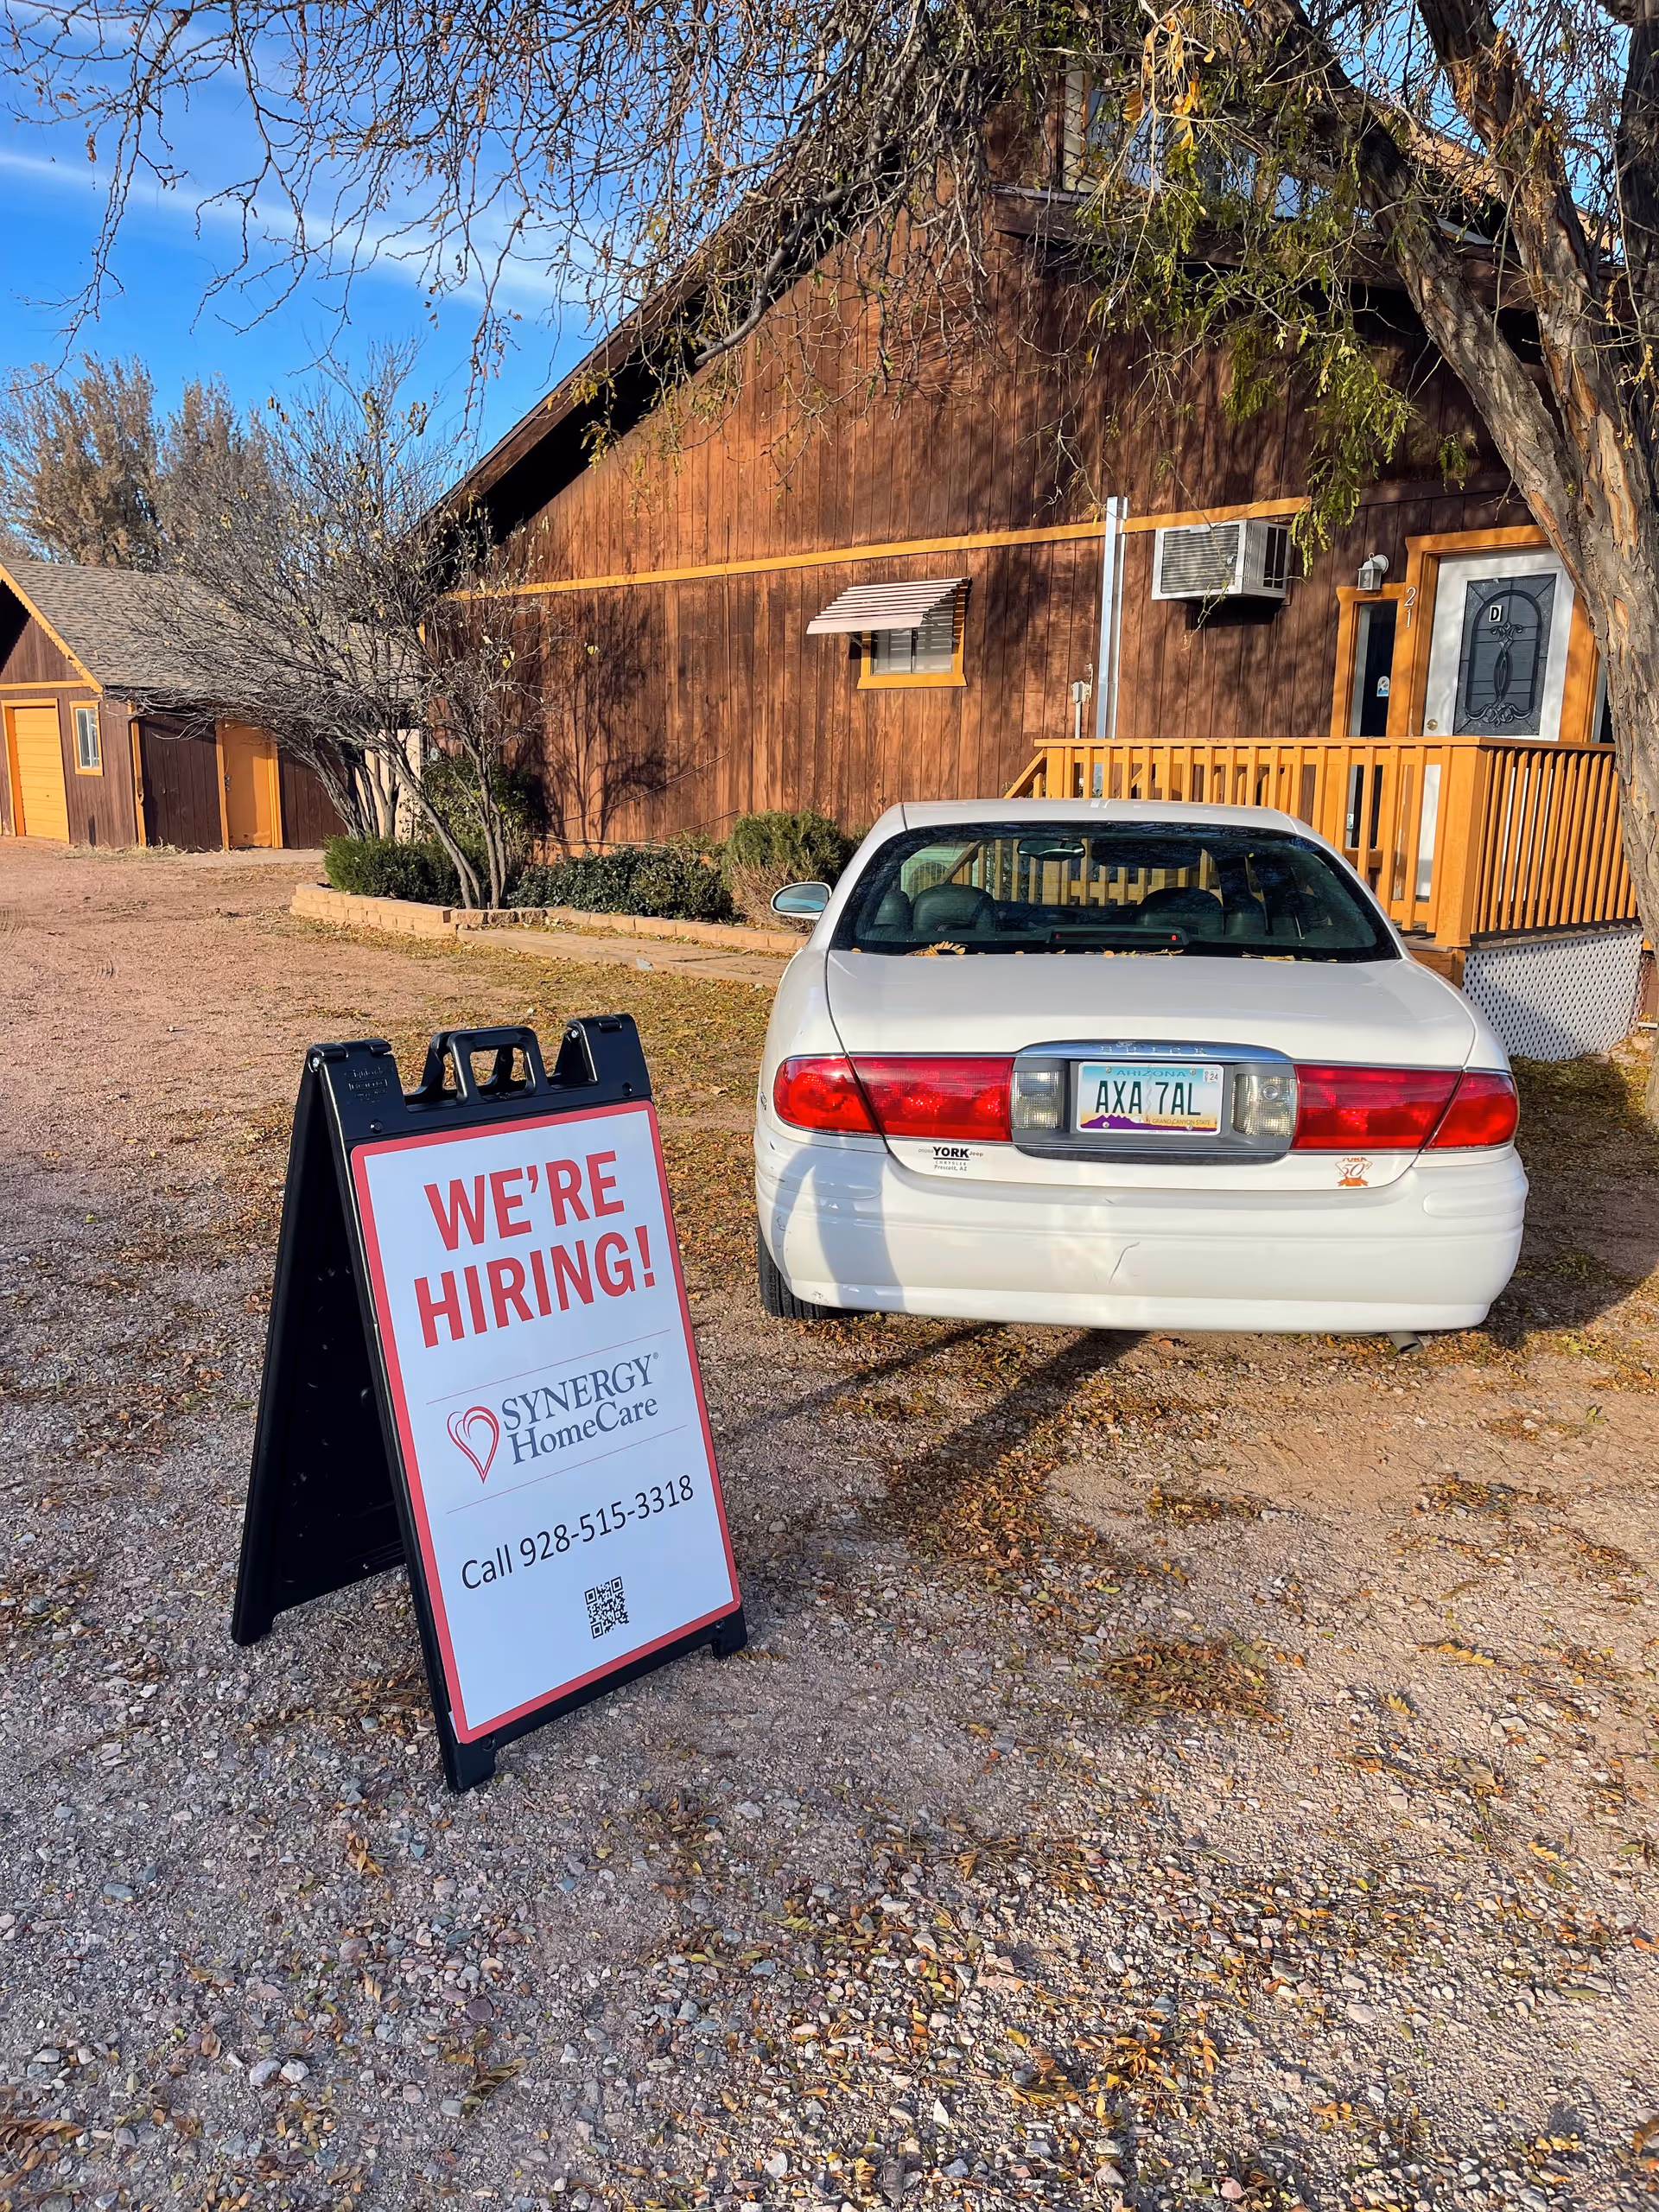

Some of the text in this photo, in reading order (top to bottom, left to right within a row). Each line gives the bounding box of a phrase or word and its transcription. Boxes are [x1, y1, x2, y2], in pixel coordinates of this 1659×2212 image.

[1491, 607, 1500, 621] D
[1100, 1046, 1207, 1055] BUICK
[1095, 1080, 1202, 1116] AXA 7AL
[932, 1147, 970, 1159] YORK
[424, 1151, 624, 1250] WE'RE
[415, 1226, 655, 1347] HIRING!
[507, 1397, 658, 1465] HomeCare
[462, 1475, 694, 1589] Call 928-515-3318
